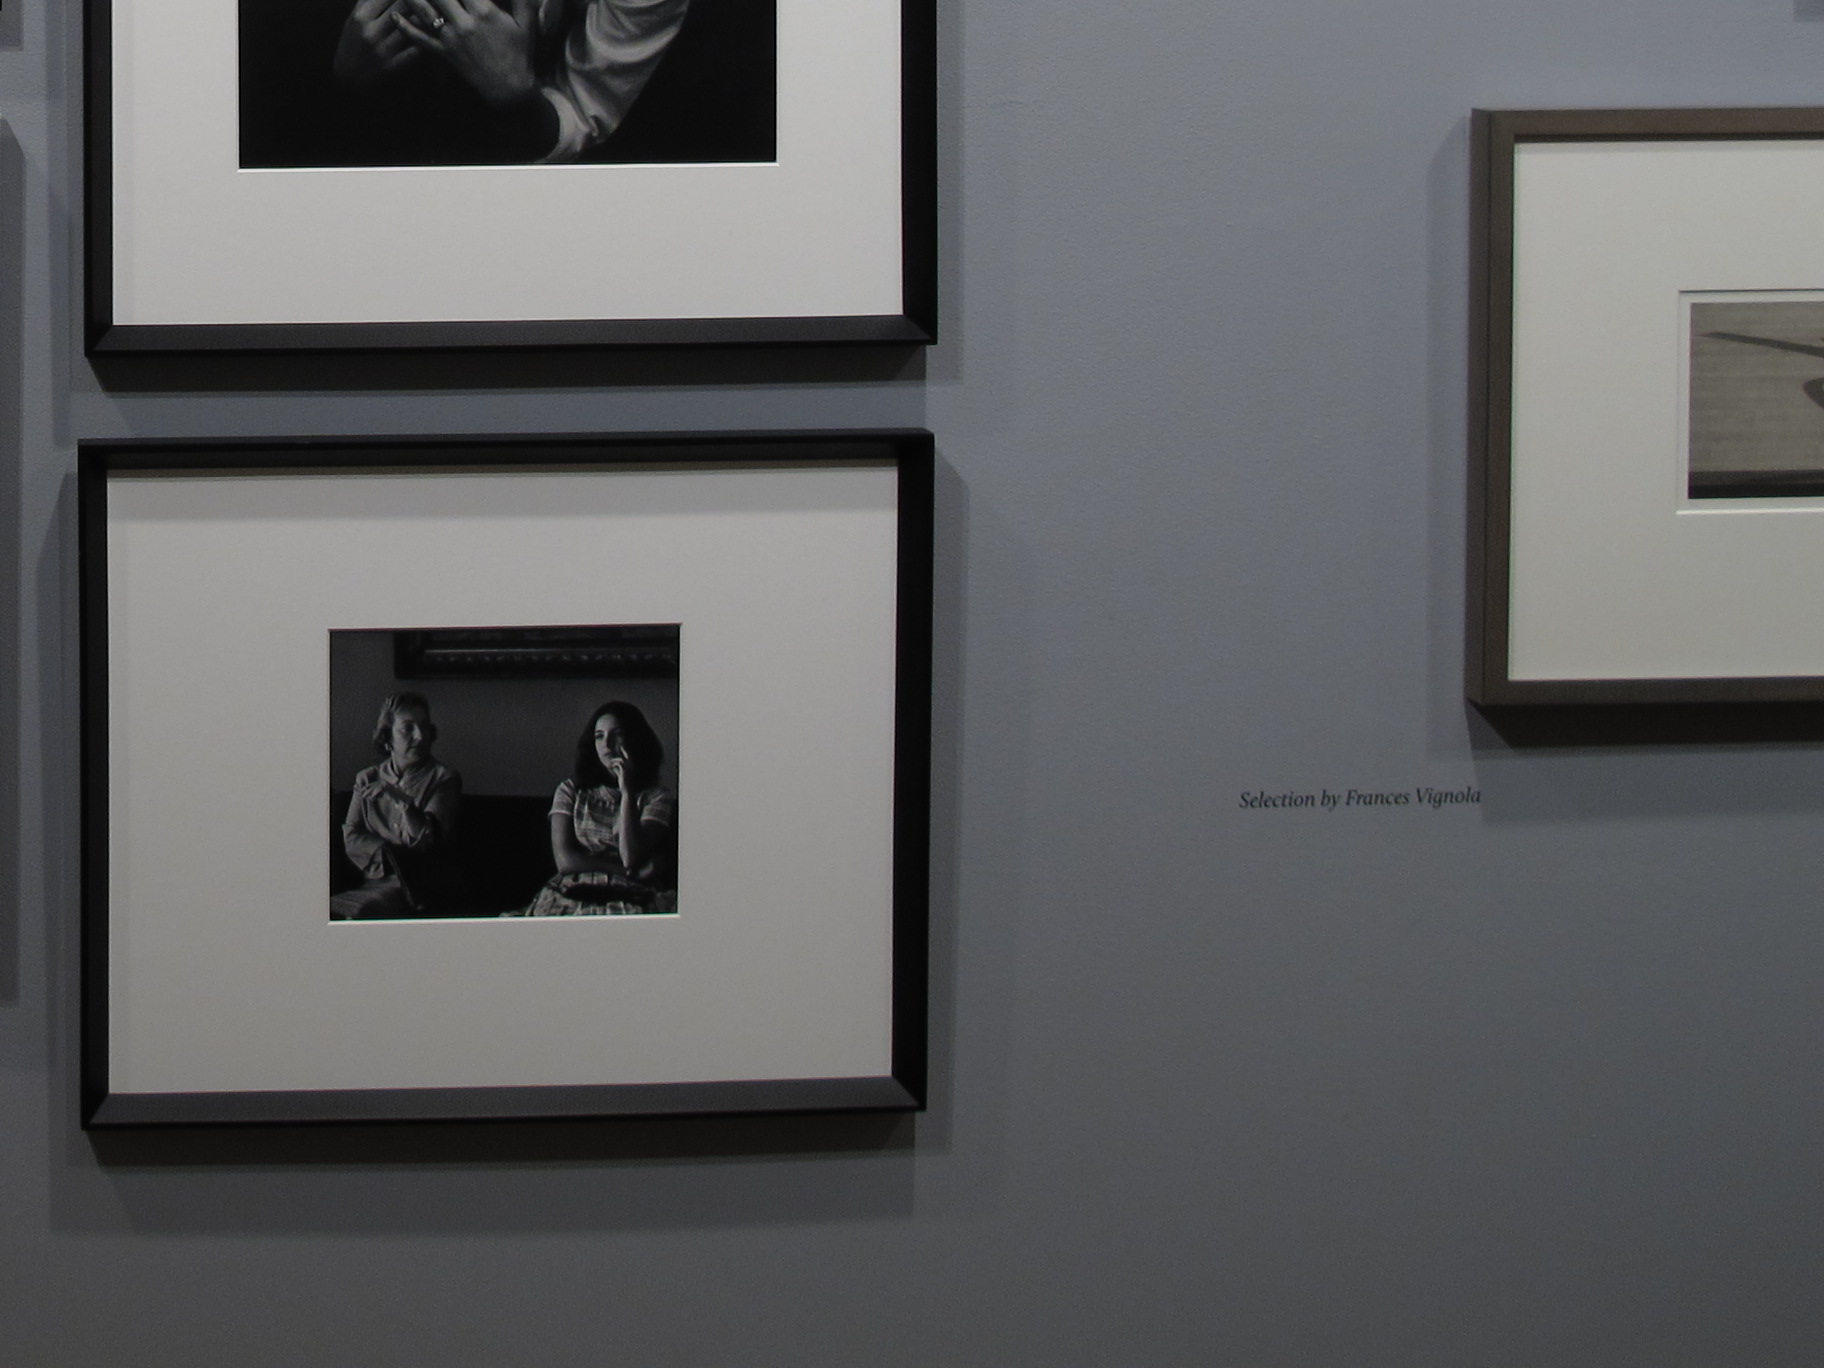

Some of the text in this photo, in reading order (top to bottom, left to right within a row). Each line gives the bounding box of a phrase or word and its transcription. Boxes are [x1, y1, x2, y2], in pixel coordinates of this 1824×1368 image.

[1239, 785, 1482, 812] Selection by Frances Vignola
